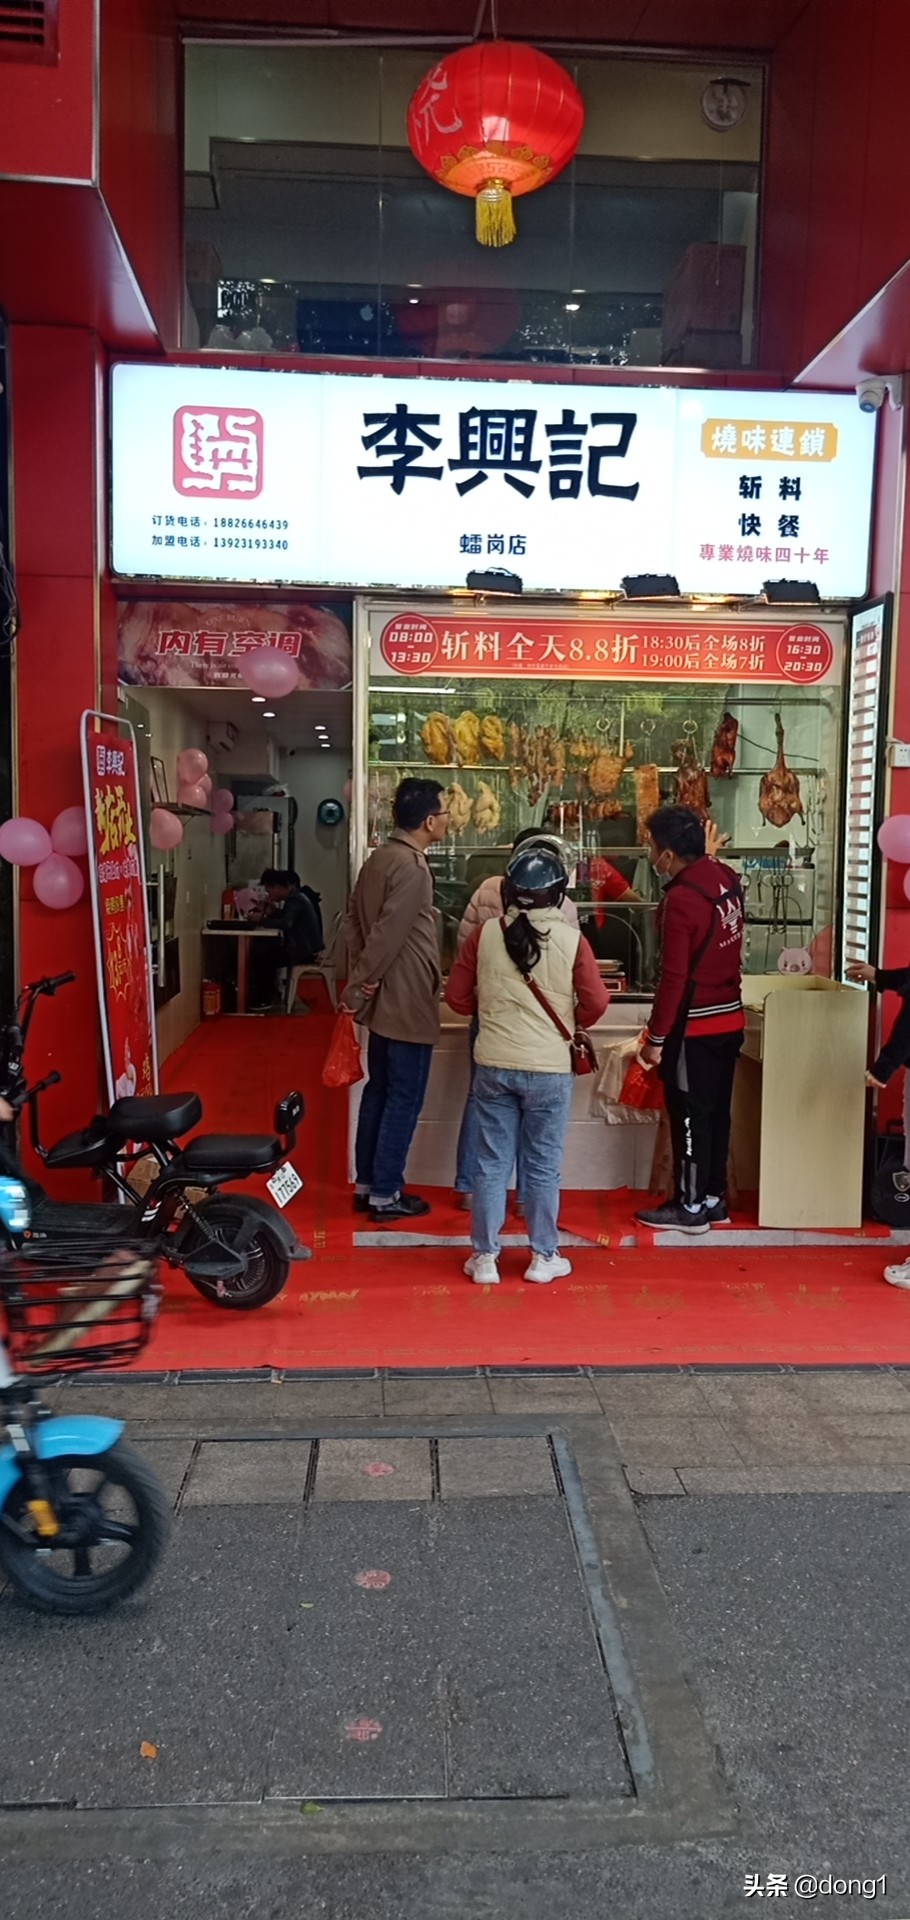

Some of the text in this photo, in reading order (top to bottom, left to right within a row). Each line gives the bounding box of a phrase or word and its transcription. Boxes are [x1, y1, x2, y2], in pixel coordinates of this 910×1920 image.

[711, 424, 826, 457] 燒味連鎖
[357, 403, 640, 502] 李興記
[738, 474, 802, 501] 斩料
[738, 512, 801, 538] 快餐
[699, 543, 830, 565] 專業燒味四十年
[156, 629, 302, 658] 内有空调
[389, 632, 433, 642] 08:00
[441, 630, 640, 663] 斩料全天8.8折
[642, 634, 766, 652] 18:30后全场8折
[391, 652, 431, 663] 13:30
[642, 652, 765, 670] 19:00后全场7折
[786, 645, 821, 655] 16:30
[784, 662, 822, 672] 20:30
